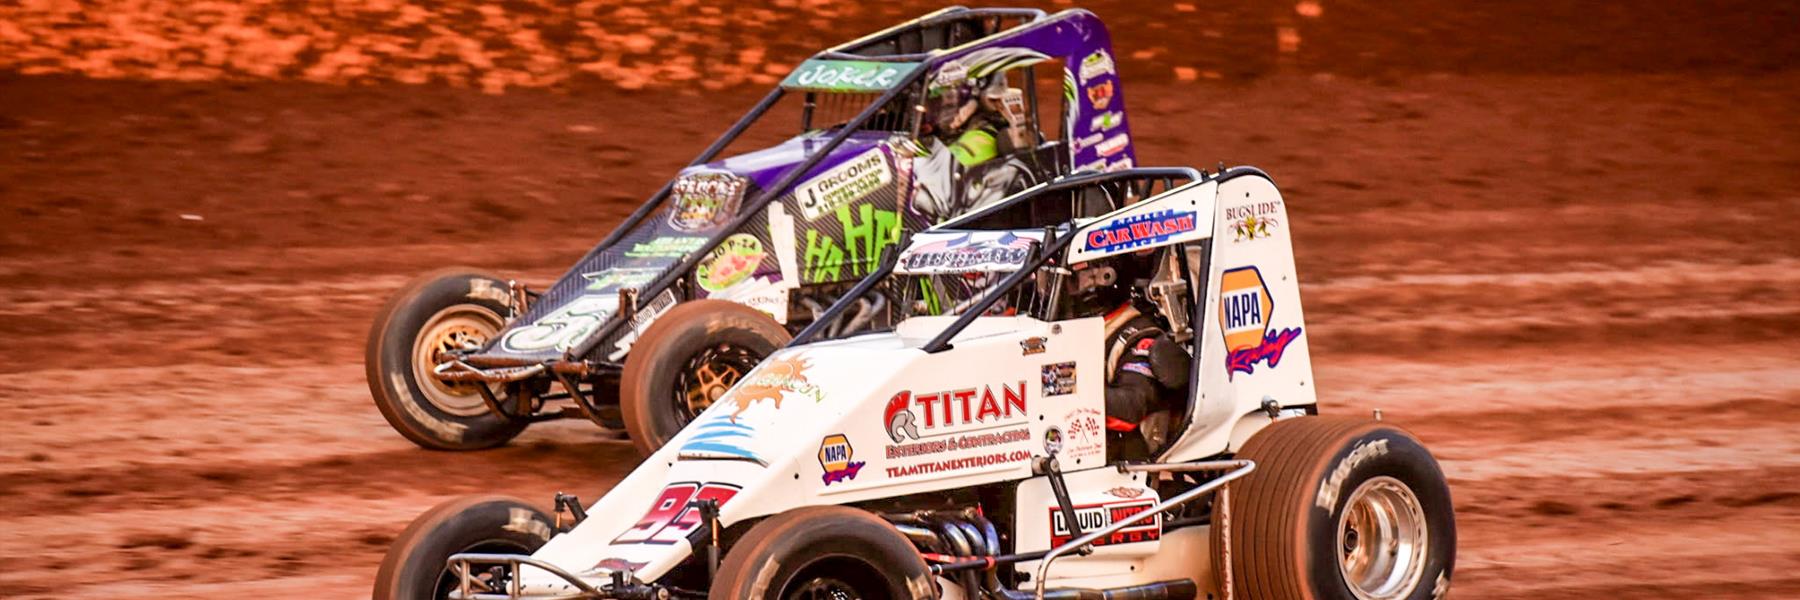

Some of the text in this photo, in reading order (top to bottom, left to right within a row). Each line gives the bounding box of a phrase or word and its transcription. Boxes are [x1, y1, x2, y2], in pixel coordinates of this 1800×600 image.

[798, 64, 897, 87] JOKER
[804, 188, 817, 208] J
[818, 155, 881, 192] GROOMS
[1224, 291, 1261, 329] NAPA
[914, 380, 1027, 429] TITAN
[825, 444, 847, 462] NAPA
[886, 439, 947, 459] EXTERIORS
[958, 428, 1031, 449] CONTRACTING
[886, 449, 1032, 478] TEAMTITANEXTERIORS.COM
[1057, 511, 1103, 531] LUID
